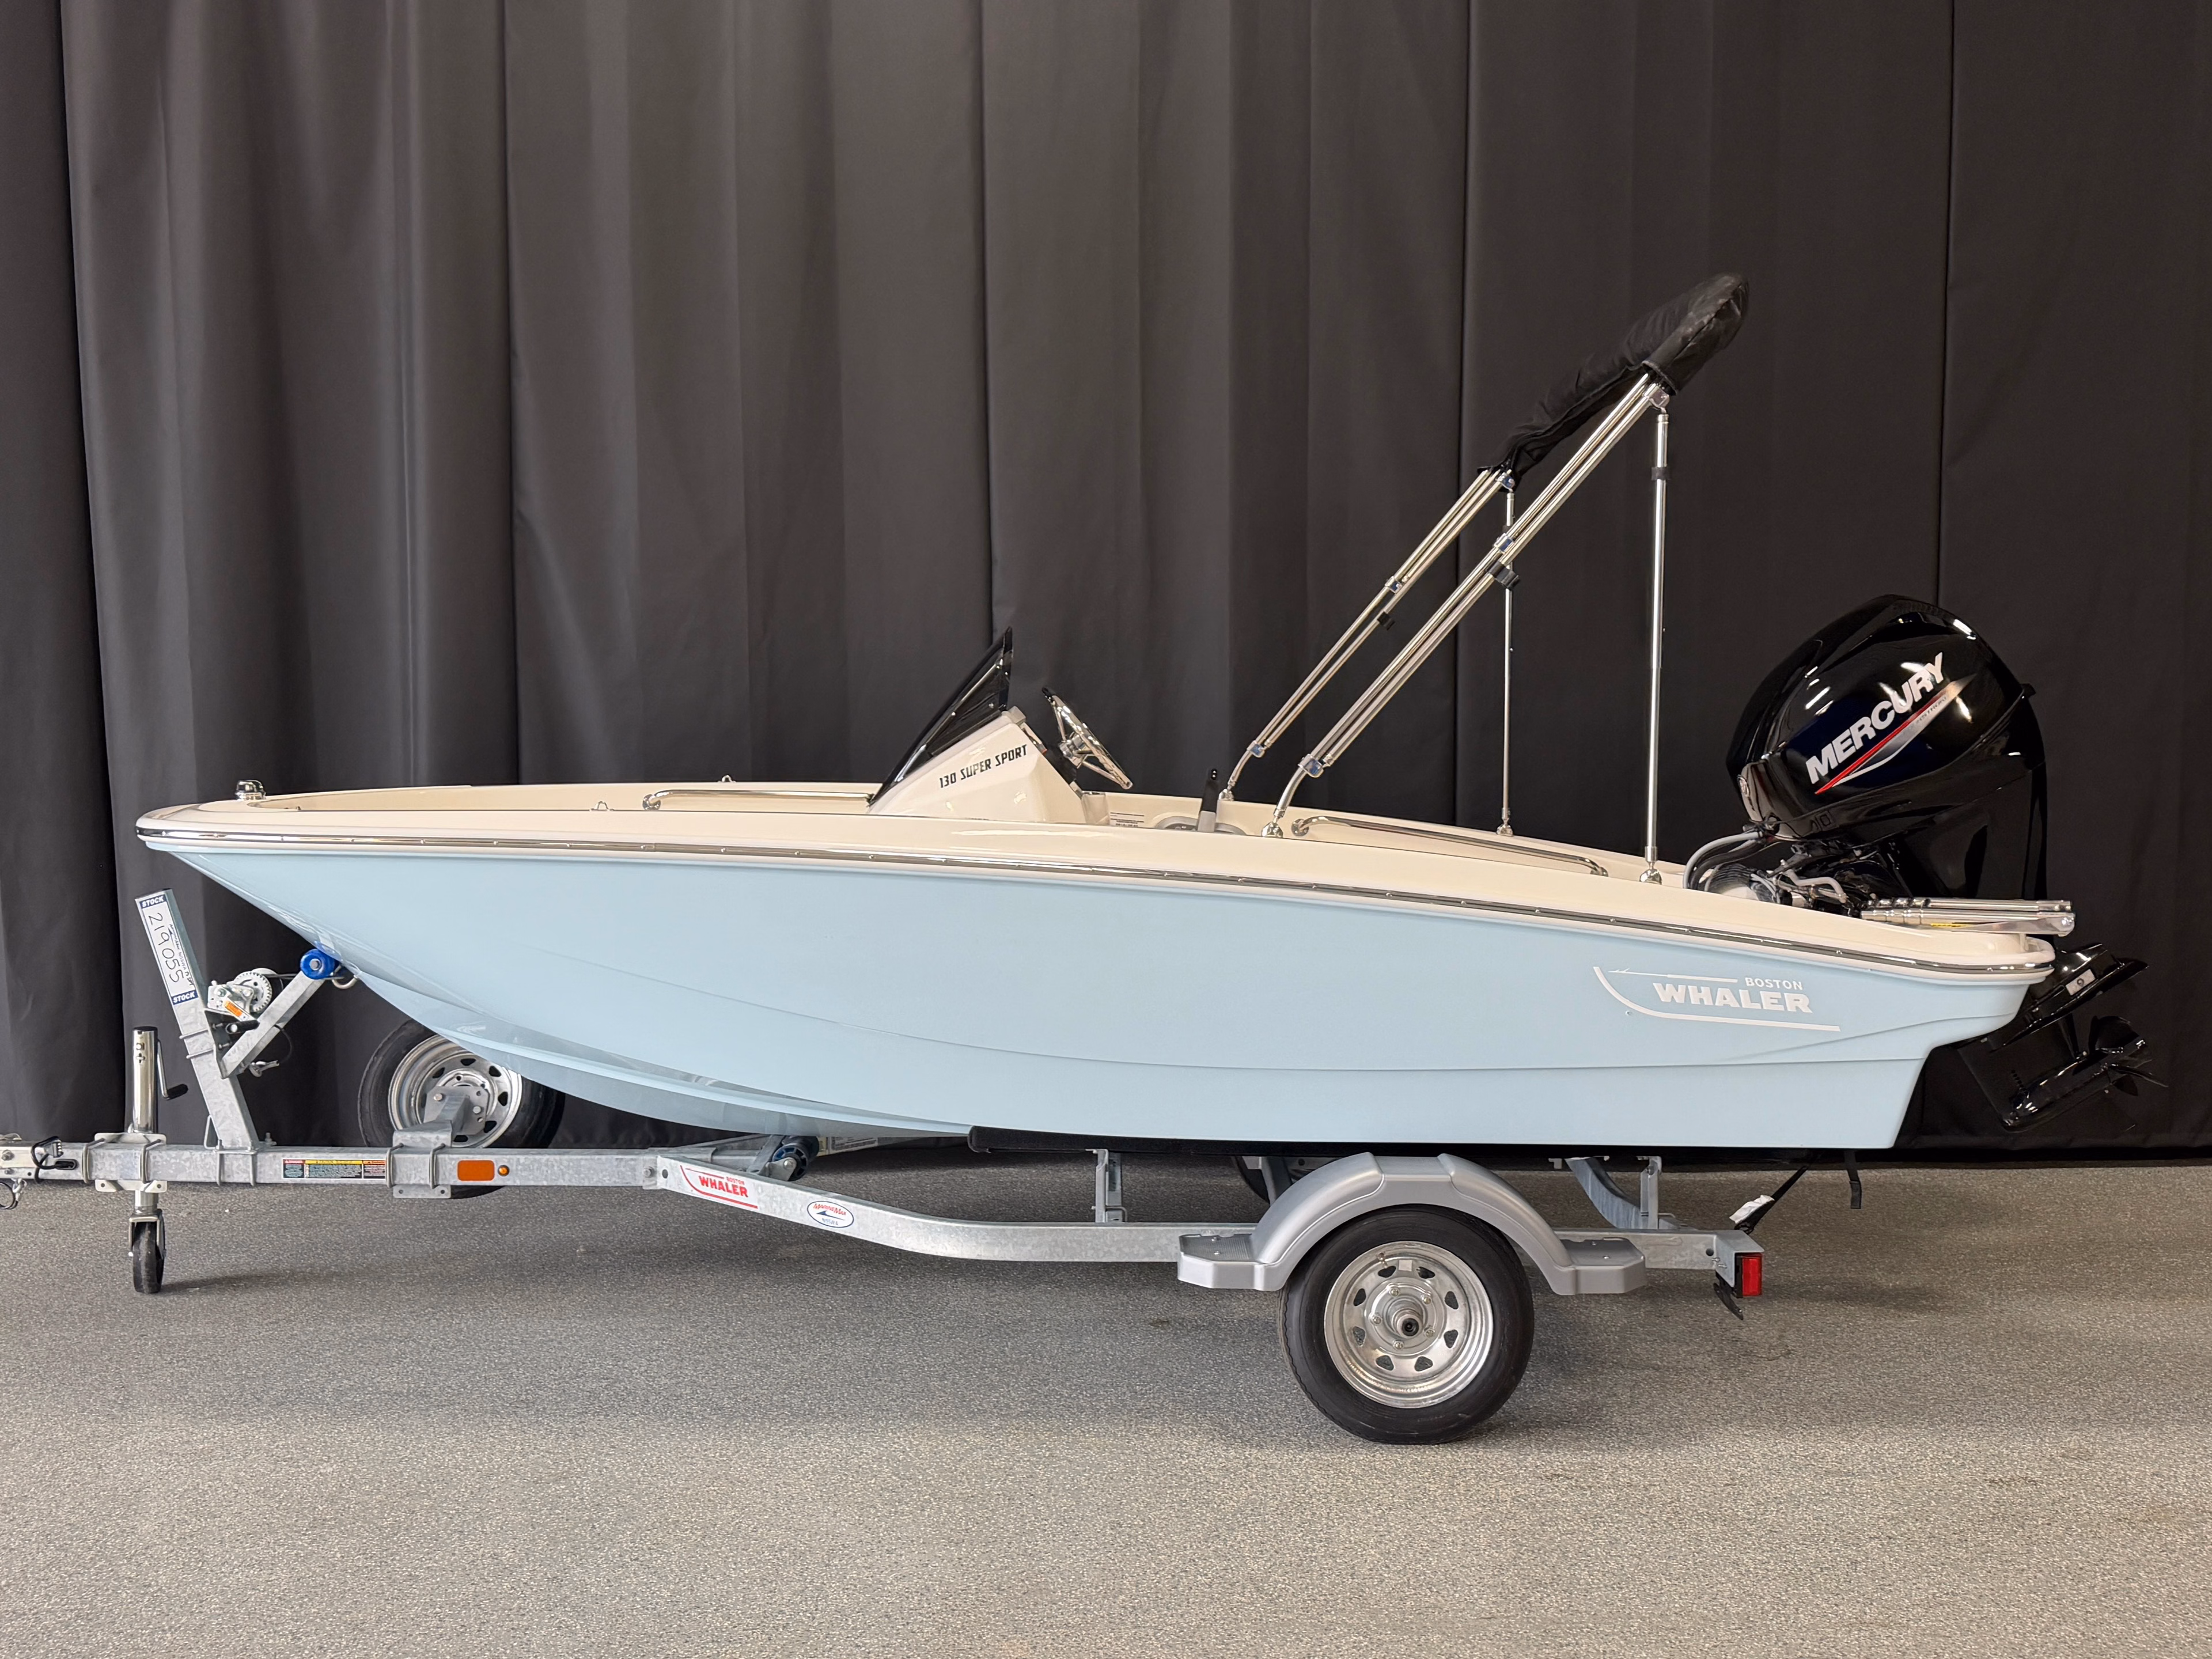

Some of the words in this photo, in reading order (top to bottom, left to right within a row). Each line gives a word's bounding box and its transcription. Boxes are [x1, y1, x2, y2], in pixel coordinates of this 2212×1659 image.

[1805, 652, 1944, 784] MERCURY
[940, 772, 956, 788] 130
[960, 759, 991, 781] SUPER
[995, 744, 1027, 767] SPORT
[142, 896, 164, 907] STOCK
[1744, 977, 1803, 990] BOSTON
[173, 991, 195, 1003] STOCK
[1653, 983, 1813, 1013] WHALER
[698, 1175, 748, 1198] WHALER
